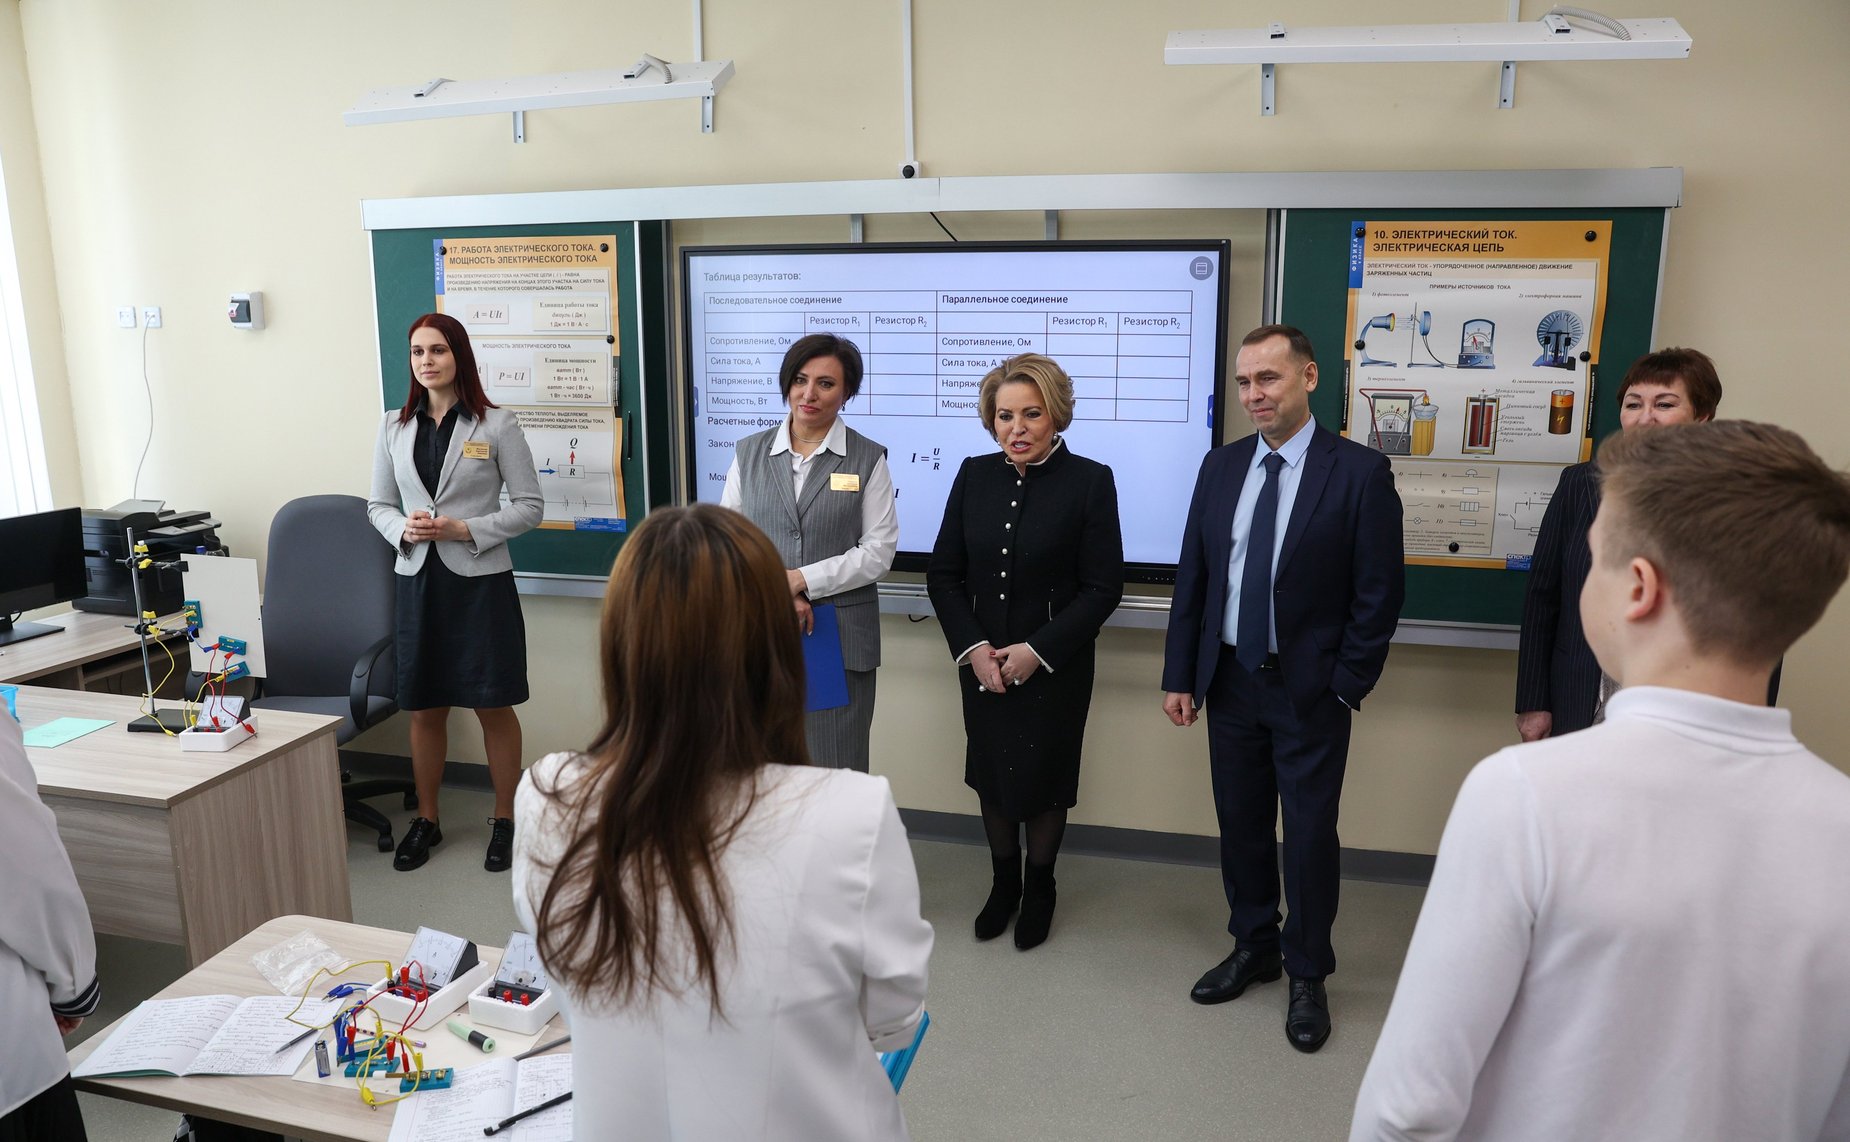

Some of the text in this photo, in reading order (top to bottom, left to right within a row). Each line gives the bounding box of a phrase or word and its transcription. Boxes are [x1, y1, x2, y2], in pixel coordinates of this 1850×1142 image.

[1374, 229, 1517, 239] 10. ЭЛЕКТРИЧЕСКИЙ ТОК.
[449, 243, 596, 254] 17. РАБОТА ЭЛЕКТРИЧЕСКОГО ТОКА.
[1373, 243, 1504, 253] ЭЛЕКТРИЧЕСКАЯ ЦЕПЬ
[449, 254, 597, 265] МОЩНОСТЬ ЭЛЕКТРИЧЕСКОГО ТОКА
[704, 272, 801, 282] Таблица результатов:
[709, 296, 842, 305] Последовательное соединение
[942, 295, 1068, 304] Параллельное соединение
[473, 310, 480, 319] A
[809, 316, 849, 325] Резистор
[875, 316, 916, 326] Резистор
[1052, 316, 1096, 327] Резистор
[1124, 317, 1168, 327] Резистор
[710, 336, 791, 346] Сопротивление, Ом
[941, 337, 1031, 347] Сопротивление, Ом
[710, 357, 761, 366] Сила тока, А
[941, 358, 997, 368] Сила тока, А
[499, 372, 505, 381] P
[514, 372, 525, 381] UI
[711, 377, 772, 386] Напряжение, В
[711, 396, 768, 406] Мощность, Вт
[707, 416, 755, 426] Расчетные
[570, 437, 578, 449] Q
[708, 439, 735, 448] Закон
[911, 453, 917, 463] I
[933, 447, 940, 456] U
[546, 458, 550, 466] I
[933, 462, 940, 470] R
[569, 468, 576, 476] R
